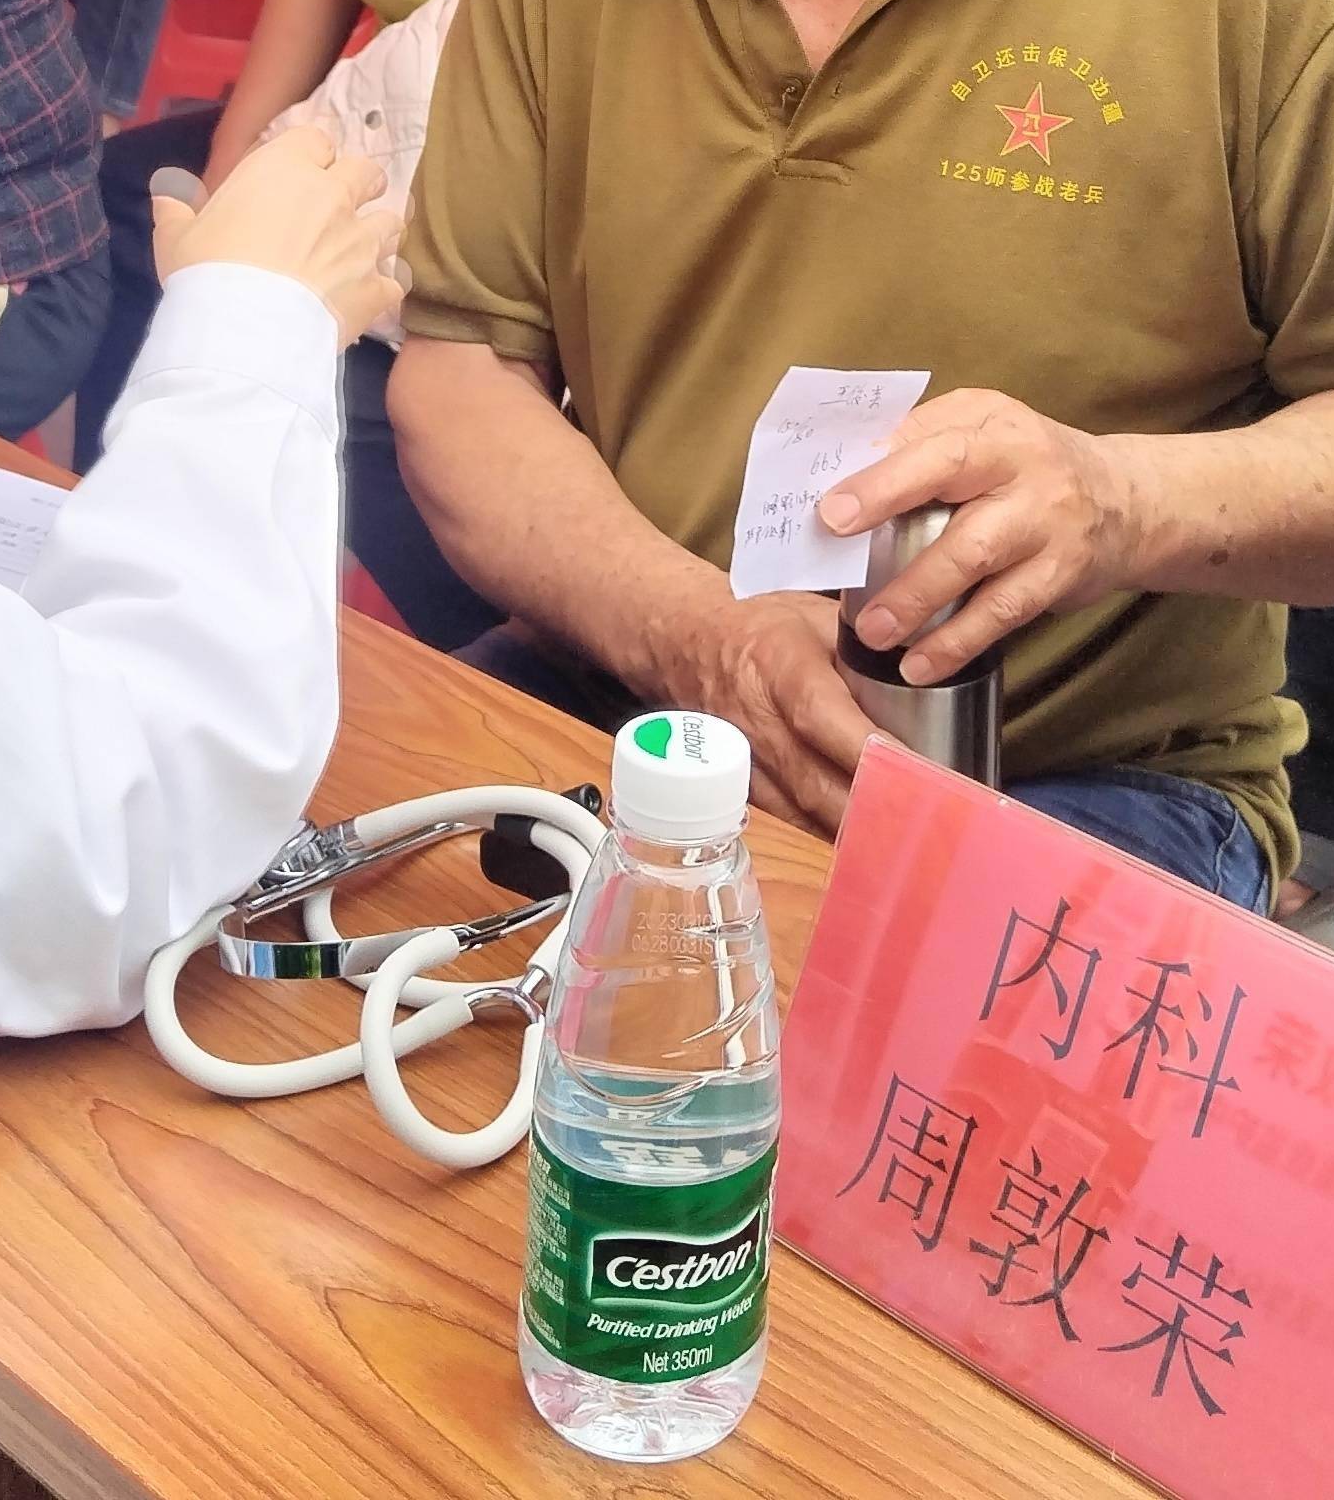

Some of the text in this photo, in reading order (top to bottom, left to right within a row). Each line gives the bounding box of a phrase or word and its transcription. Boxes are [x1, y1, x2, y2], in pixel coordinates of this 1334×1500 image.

[979, 897, 1249, 1138] 内科
[836, 1072, 1254, 1416] 周敦荣
[587, 1293, 756, 1339] Purified Drinking Water
[642, 1345, 713, 1374] Net 350ml
